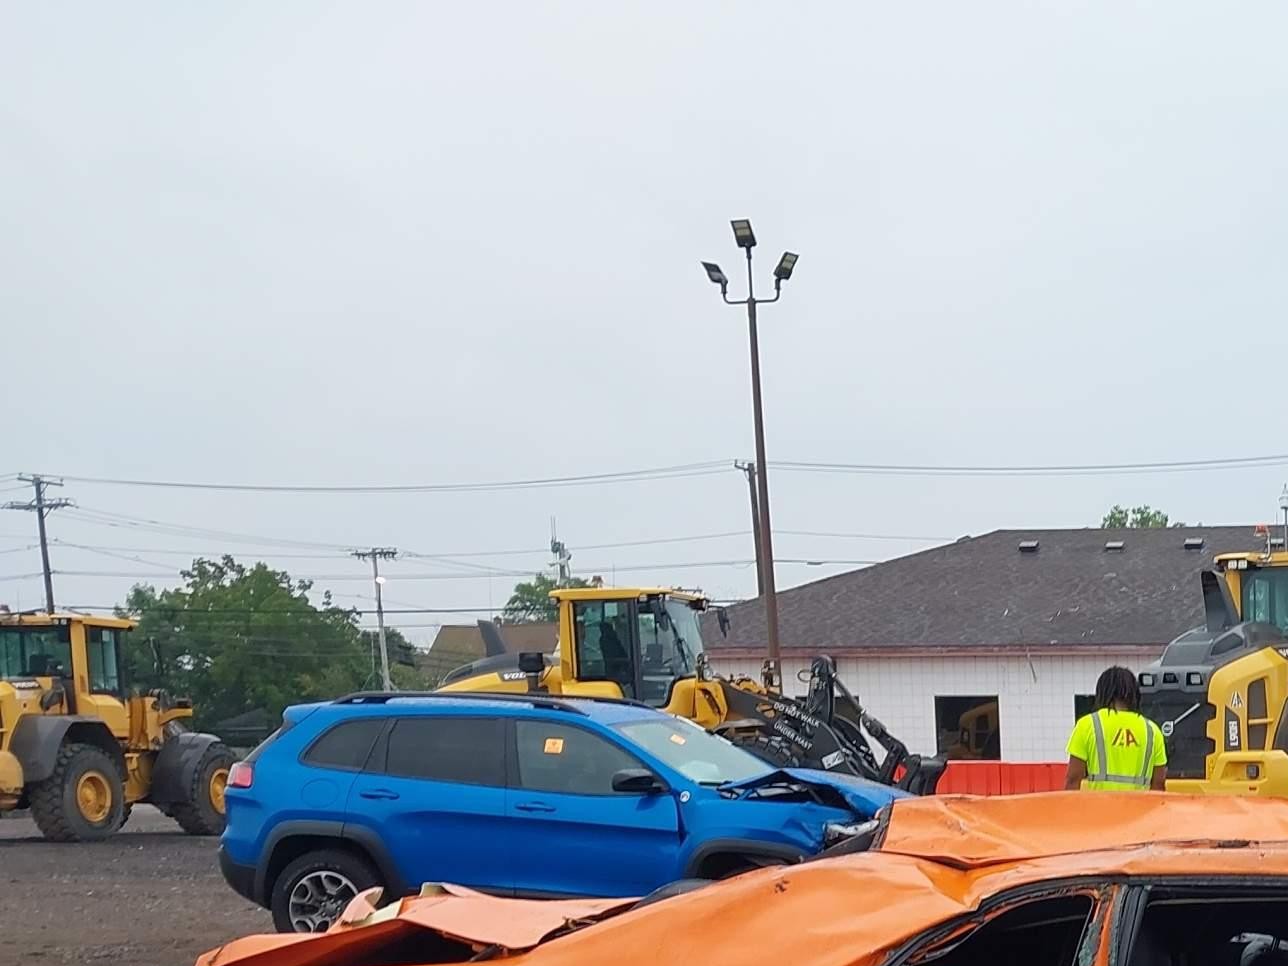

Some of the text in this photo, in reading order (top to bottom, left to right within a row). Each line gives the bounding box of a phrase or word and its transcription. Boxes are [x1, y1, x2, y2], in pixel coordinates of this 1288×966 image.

[503, 672, 527, 681] VOL
[773, 701, 821, 728] DO NOT WALK
[773, 720, 813, 750] UNDER MAST
